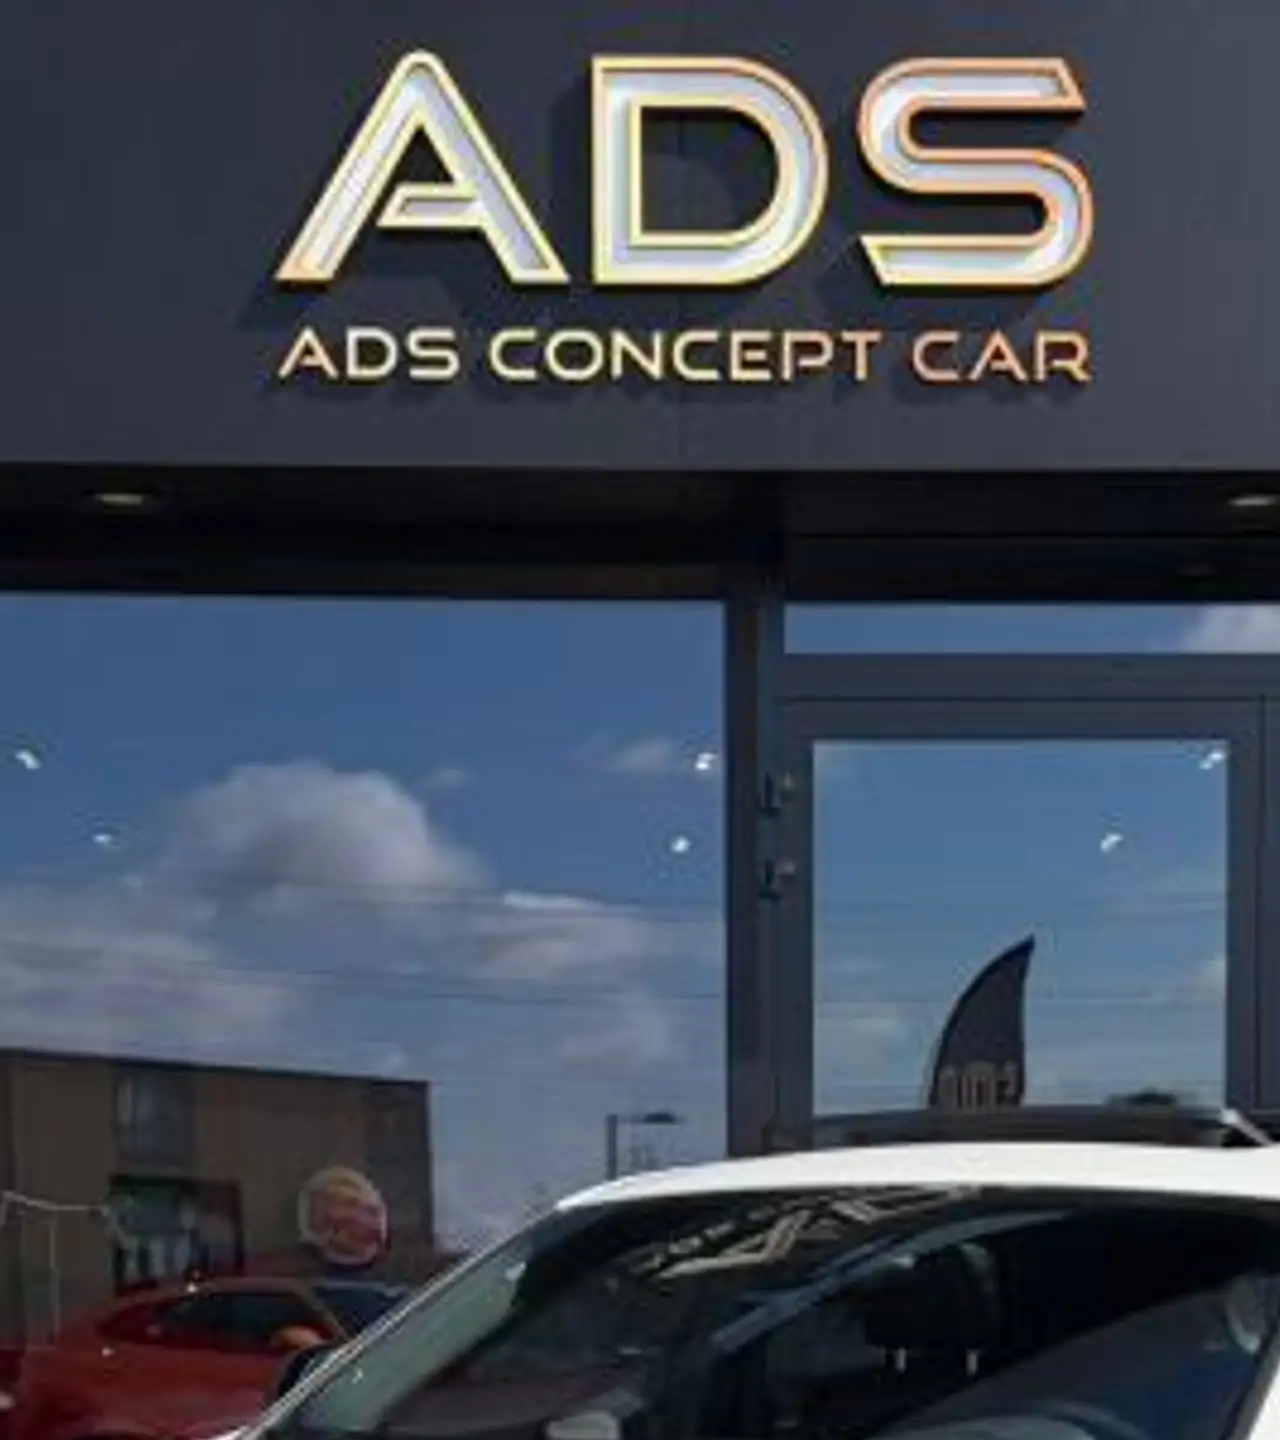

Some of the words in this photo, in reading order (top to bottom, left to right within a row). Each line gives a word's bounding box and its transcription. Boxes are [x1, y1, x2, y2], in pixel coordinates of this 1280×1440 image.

[275, 50, 1094, 285] ADS
[278, 328, 461, 383] ADS
[490, 328, 882, 383] CONCEPT
[911, 328, 1092, 383] CAR
